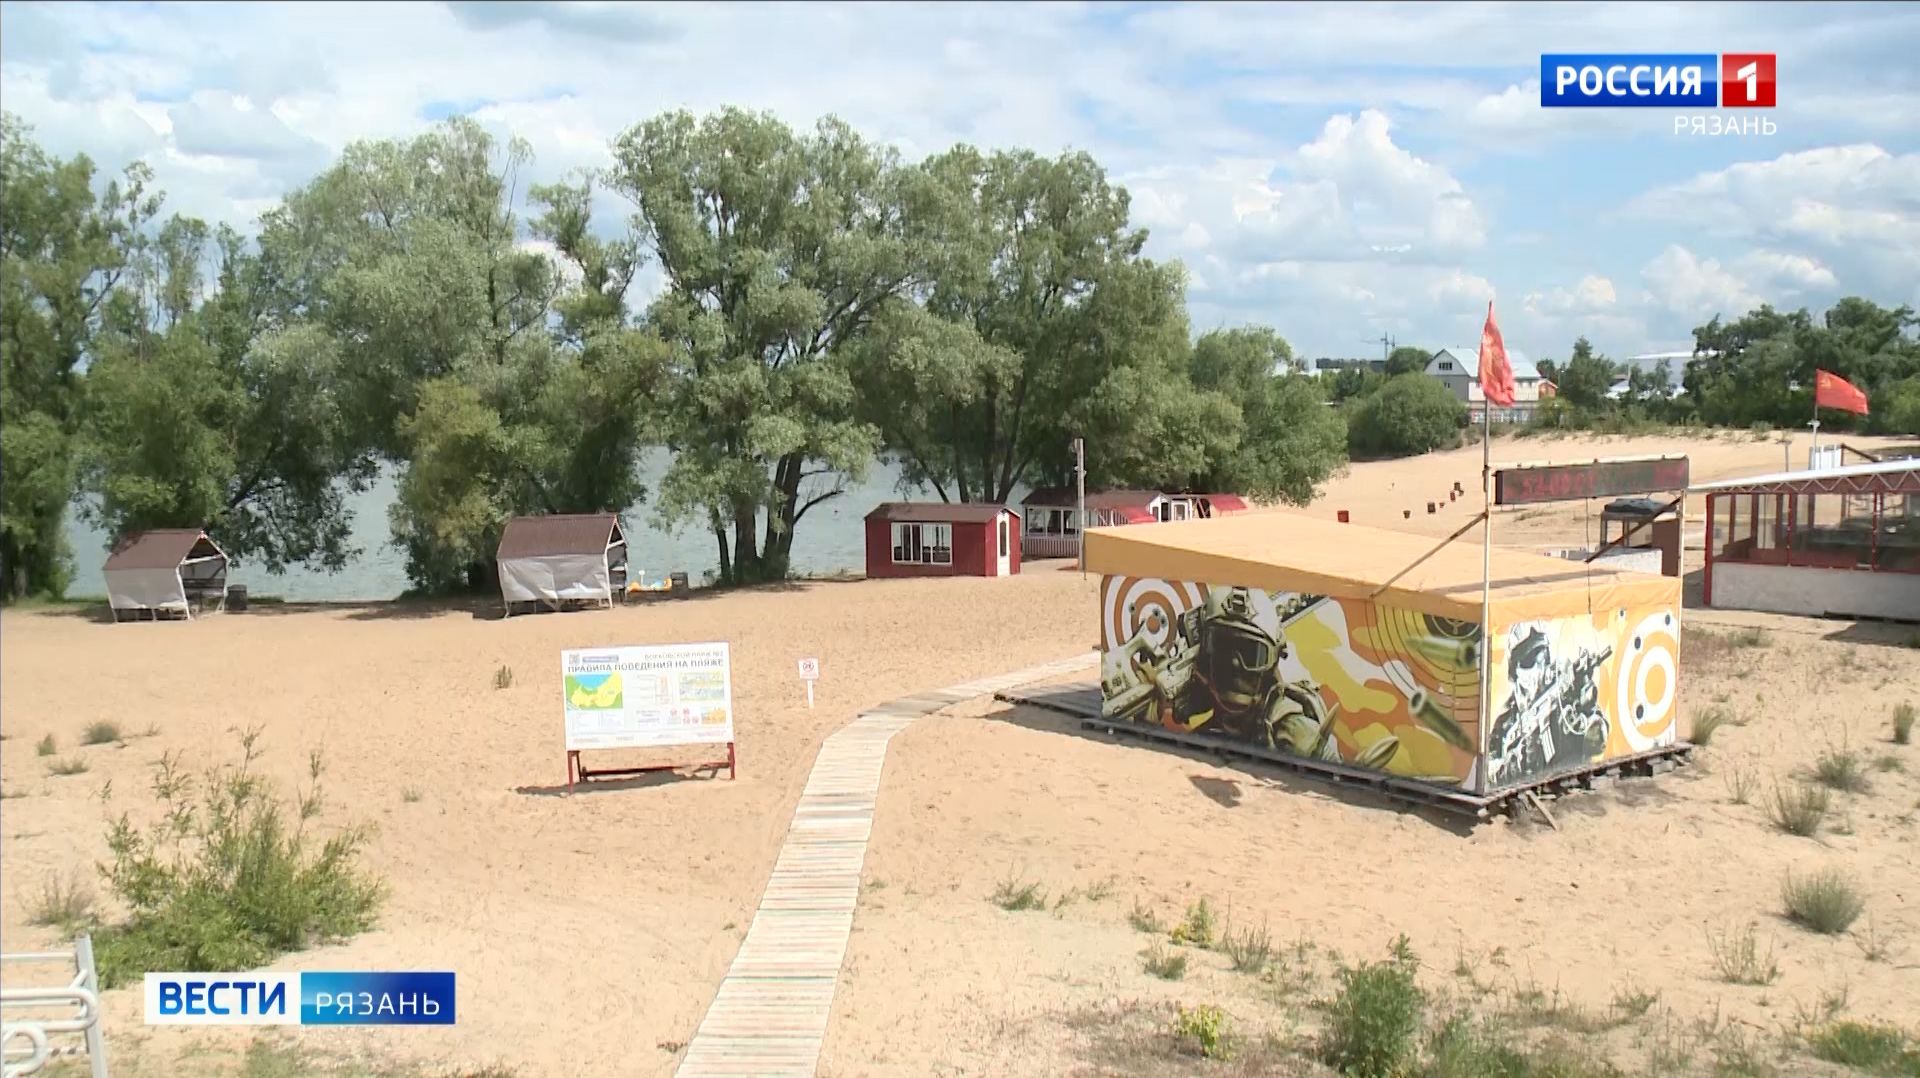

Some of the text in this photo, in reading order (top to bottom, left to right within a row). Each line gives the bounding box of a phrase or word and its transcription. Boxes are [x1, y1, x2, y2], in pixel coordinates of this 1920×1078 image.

[568, 658, 724, 673] ПРАВИЛА ПОВЕДЕНИЯ НА ПЛЯЖЕ
